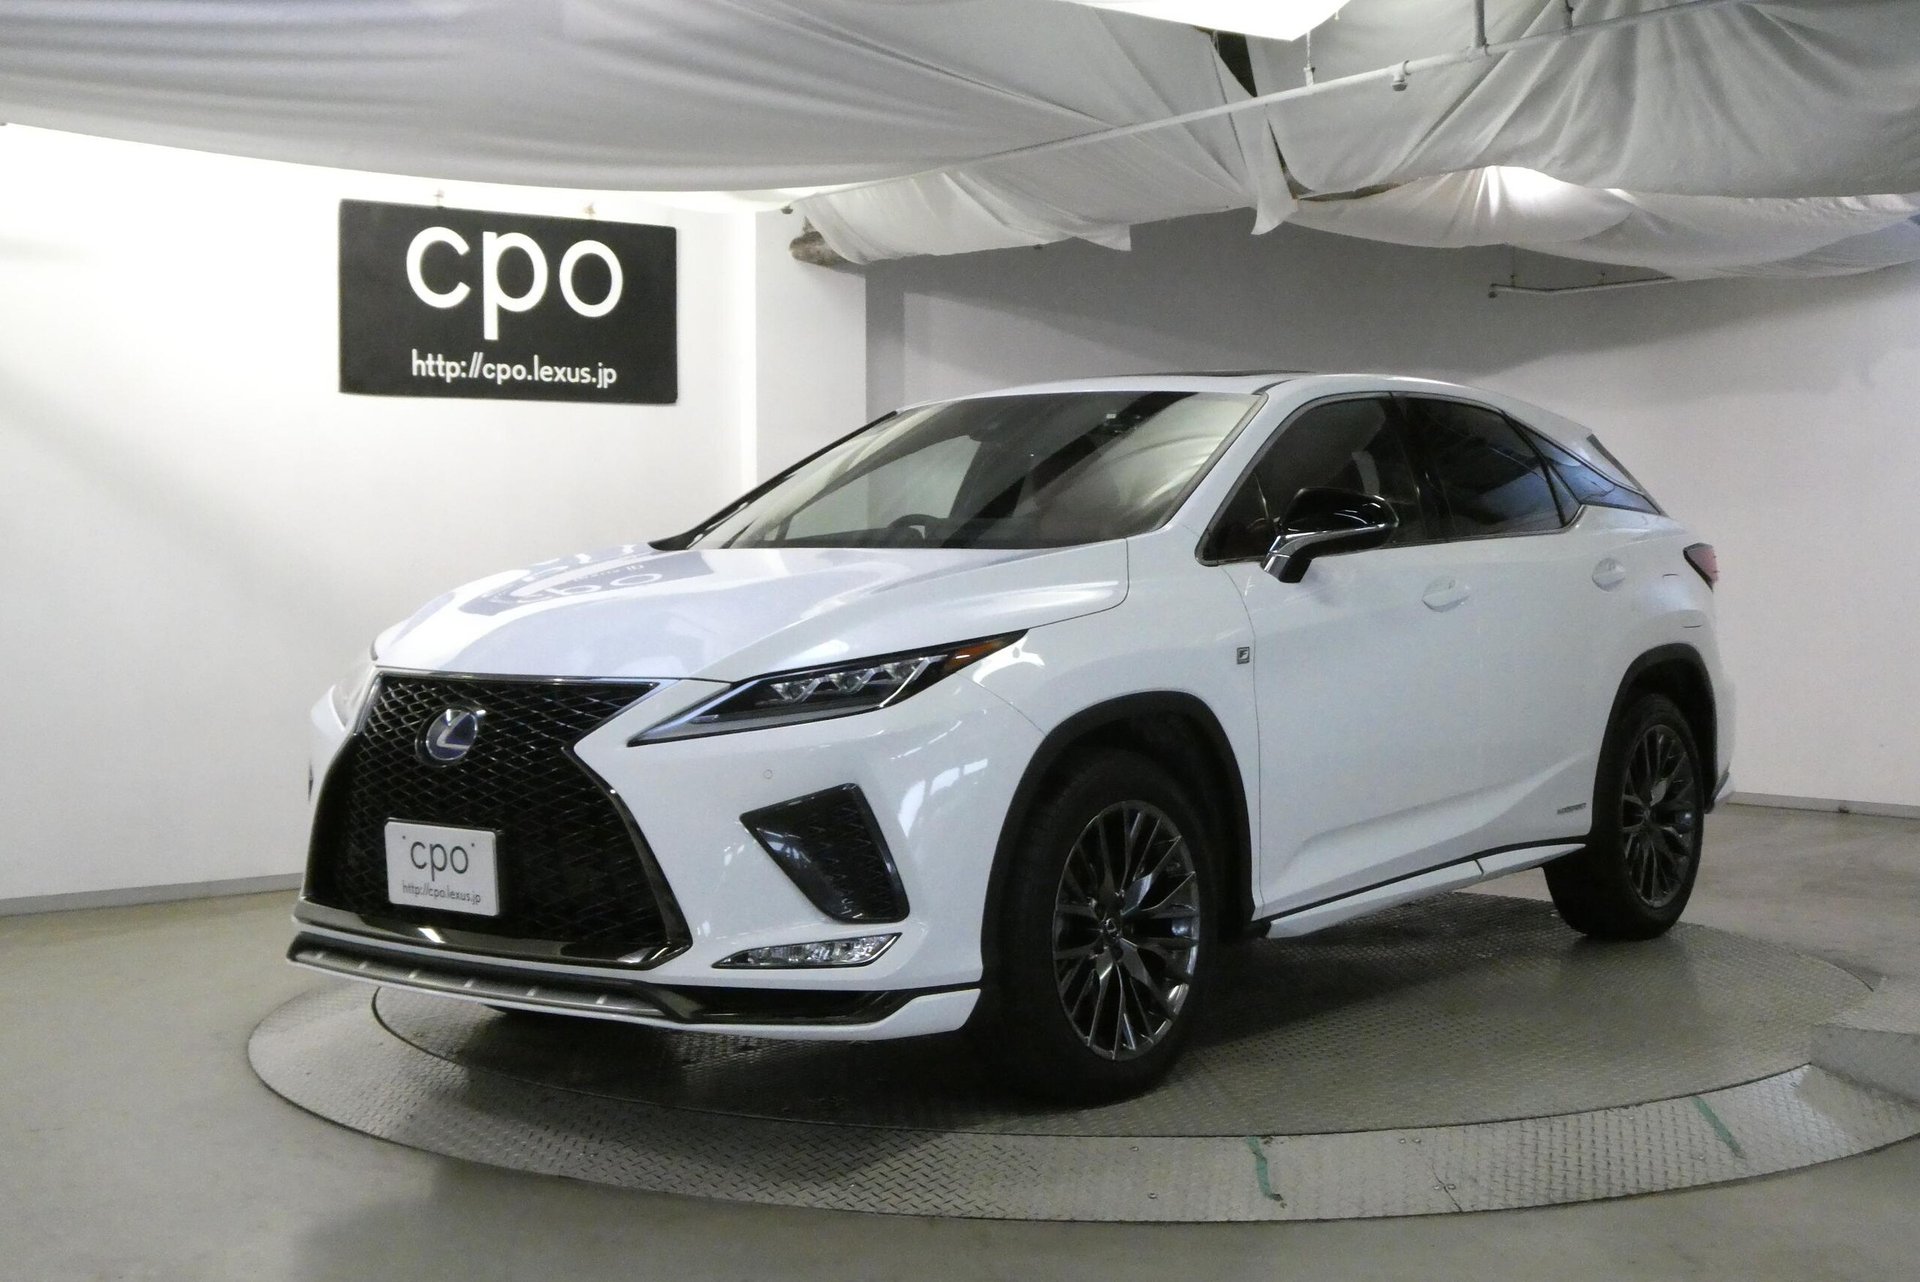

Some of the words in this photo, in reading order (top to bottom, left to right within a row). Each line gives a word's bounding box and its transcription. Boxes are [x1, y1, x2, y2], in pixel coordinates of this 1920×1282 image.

[406, 226, 623, 341] cpo
[411, 348, 618, 388] http://cpo.lexus.jp
[410, 841, 469, 882] cpo
[402, 880, 482, 905] http://cpo.lexus.jp
